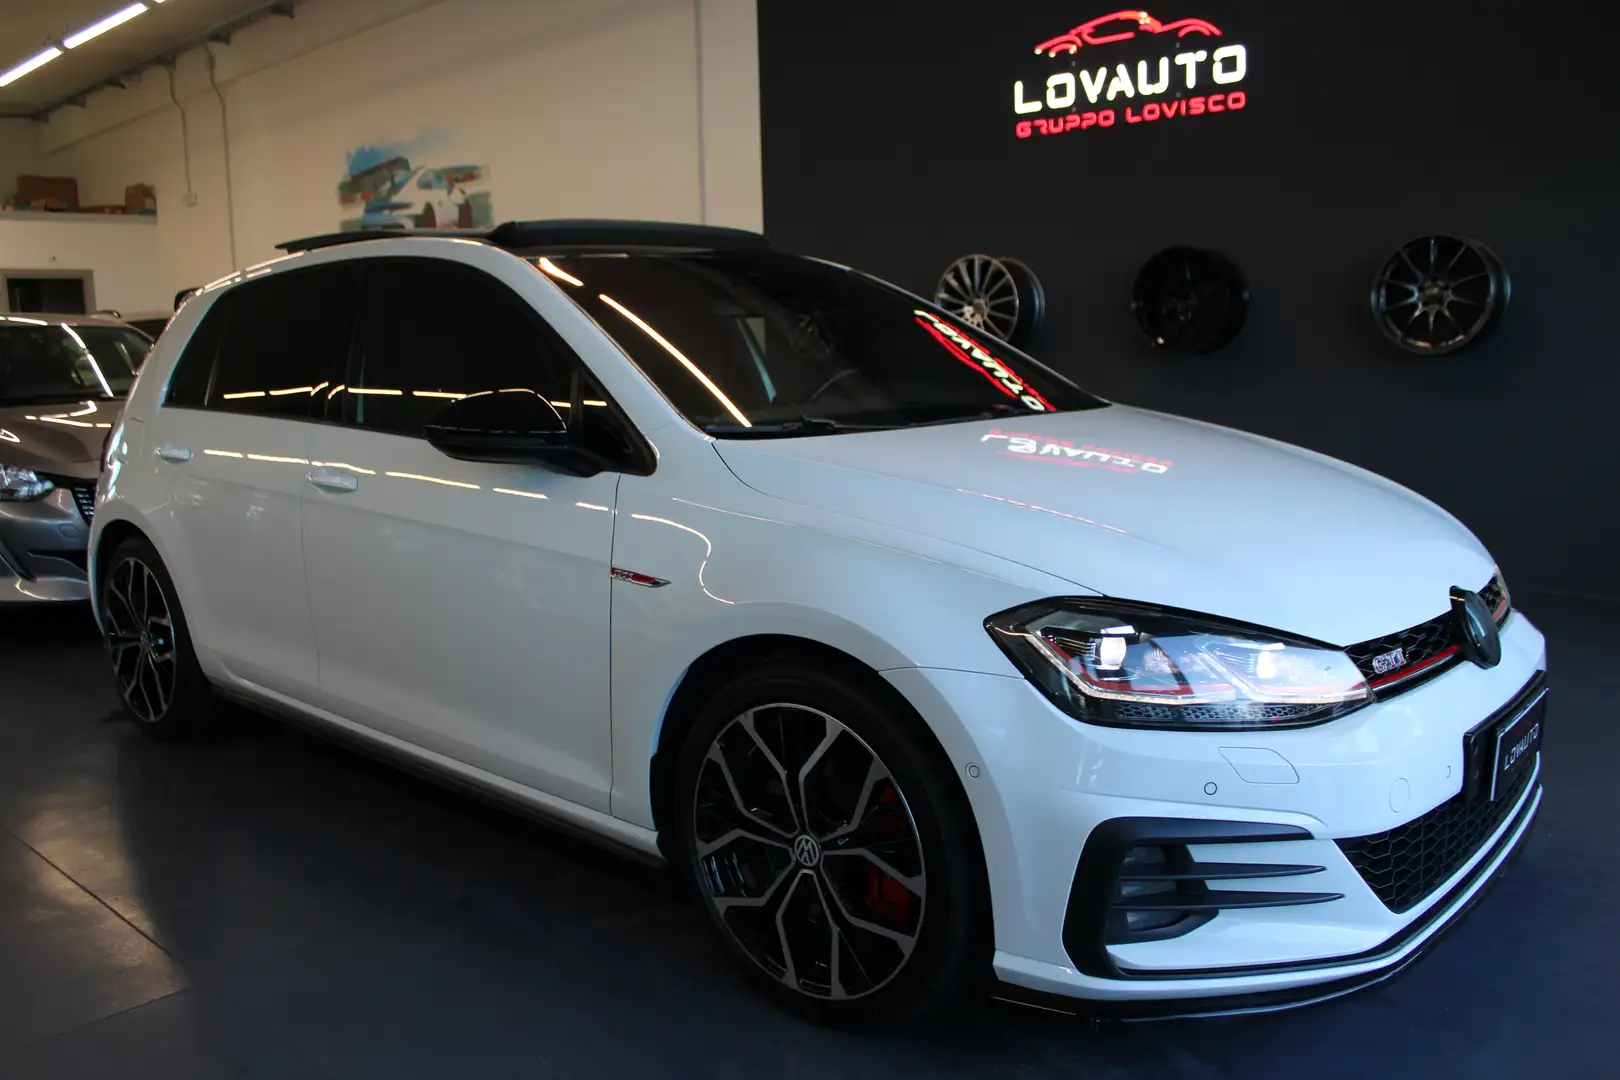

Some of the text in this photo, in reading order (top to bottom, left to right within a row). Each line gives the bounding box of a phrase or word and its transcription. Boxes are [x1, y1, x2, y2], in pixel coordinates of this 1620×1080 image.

[1014, 44, 1247, 114] LOVAUTO
[1015, 91, 1247, 139] GRUPPO LOVISCO
[1372, 648, 1406, 674] GTI
